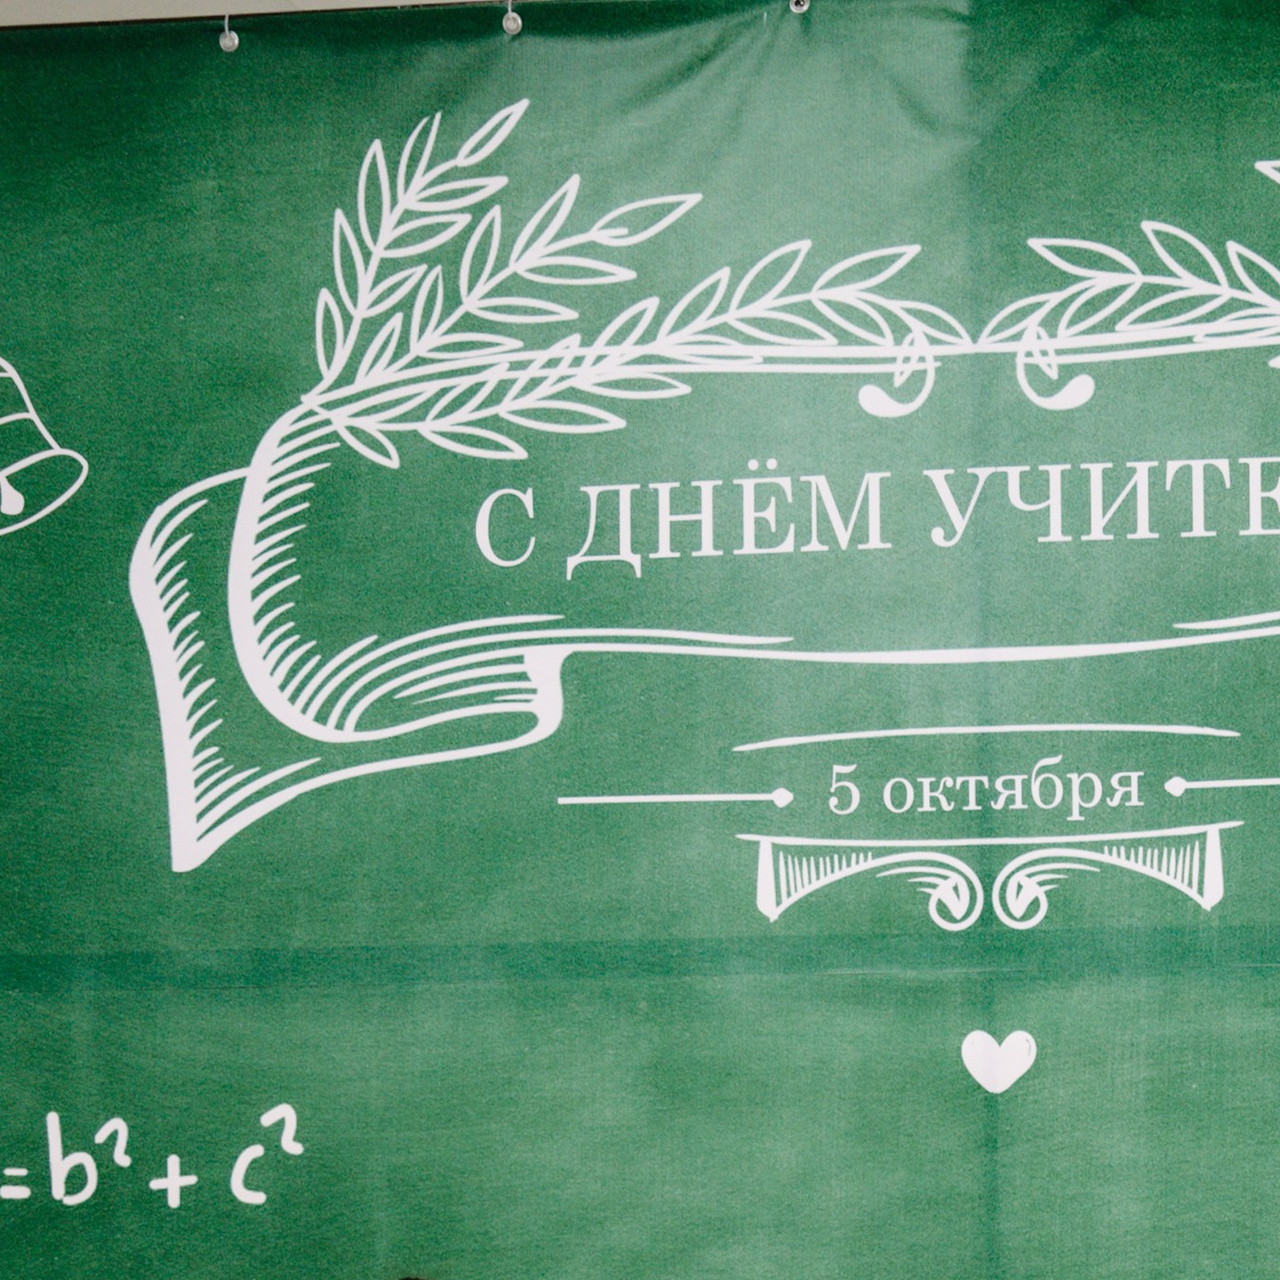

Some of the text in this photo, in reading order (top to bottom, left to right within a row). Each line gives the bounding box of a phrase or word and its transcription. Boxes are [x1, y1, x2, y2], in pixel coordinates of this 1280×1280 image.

[475, 487, 536, 567] С
[566, 457, 893, 581] ДНЁМ
[828, 754, 1145, 821] 5 октября
